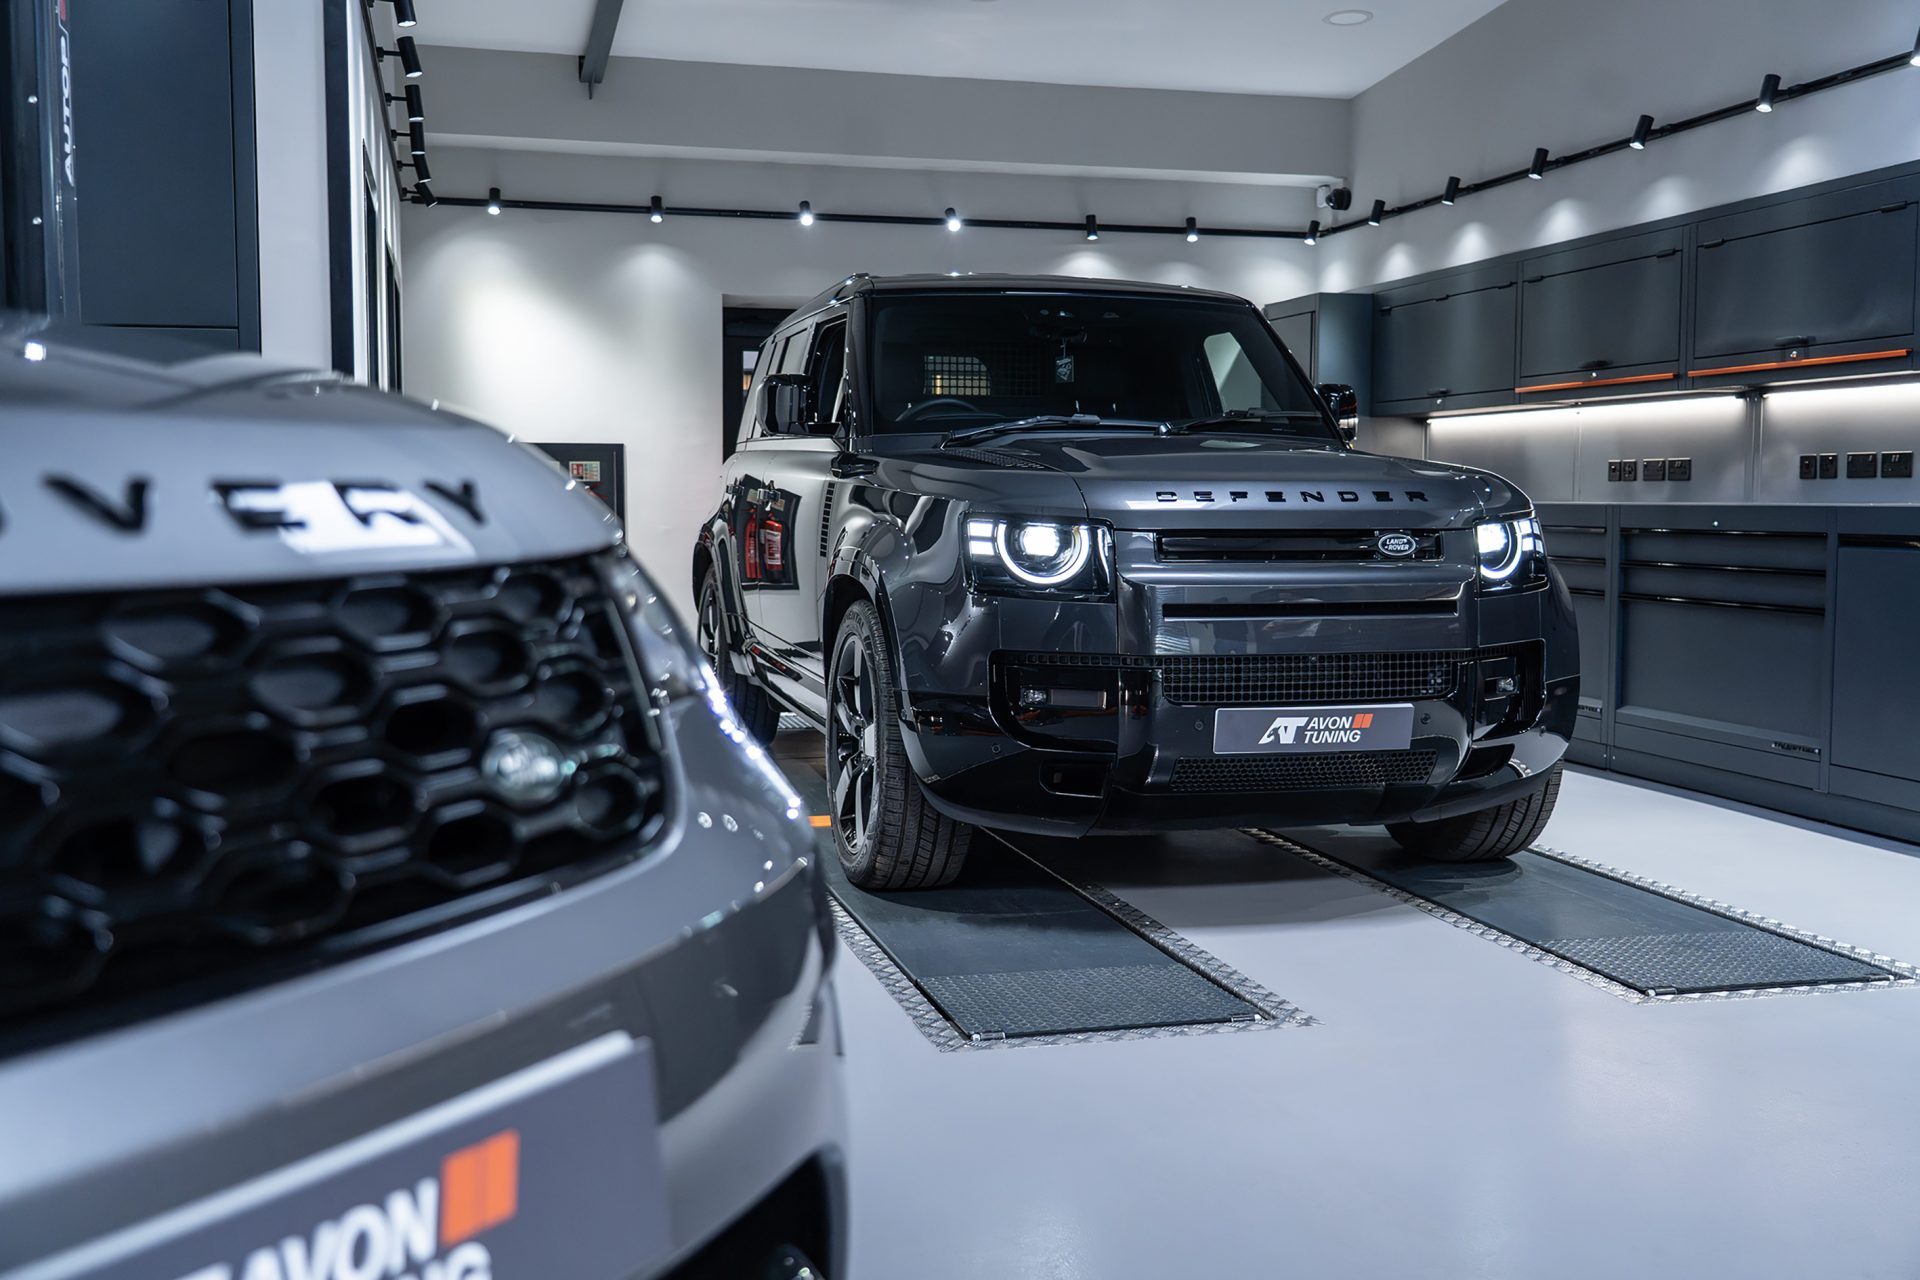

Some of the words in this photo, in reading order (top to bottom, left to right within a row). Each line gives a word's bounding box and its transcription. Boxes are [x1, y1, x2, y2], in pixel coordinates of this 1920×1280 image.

[1156, 491, 1429, 503] DEFENDER
[0, 476, 487, 536] VERY
[1307, 716, 1352, 730] AVON
[1304, 730, 1361, 744] TUNING
